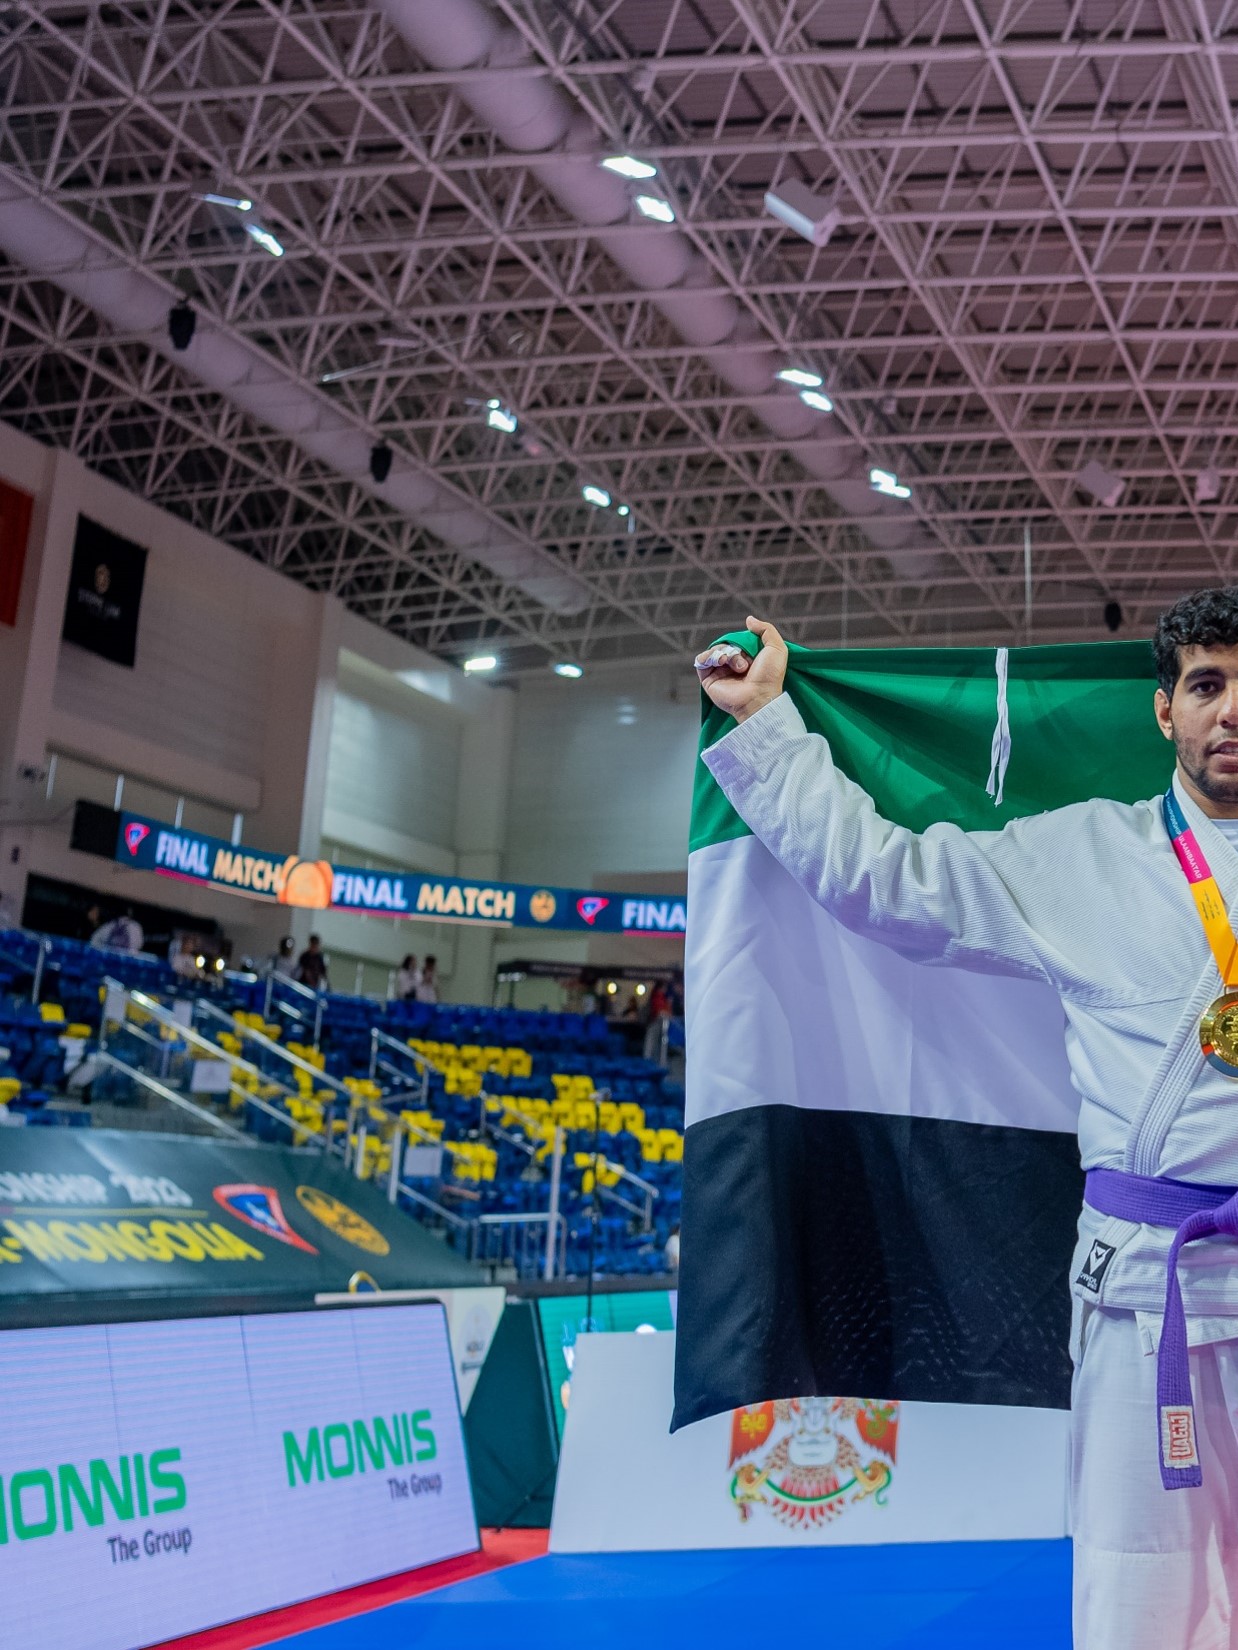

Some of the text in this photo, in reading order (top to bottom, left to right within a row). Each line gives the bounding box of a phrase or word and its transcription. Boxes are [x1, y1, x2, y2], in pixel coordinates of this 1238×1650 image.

[155, 830, 284, 893] FINAL MATCH
[1177, 835, 1203, 880] ULAANBAATAR
[331, 871, 516, 919] FINAL MATCH
[283, 1408, 437, 1488] MONNIS
[0, 1447, 187, 1544] ONNIS
[387, 1473, 442, 1500] The Group
[106, 1527, 192, 1564] The Group
